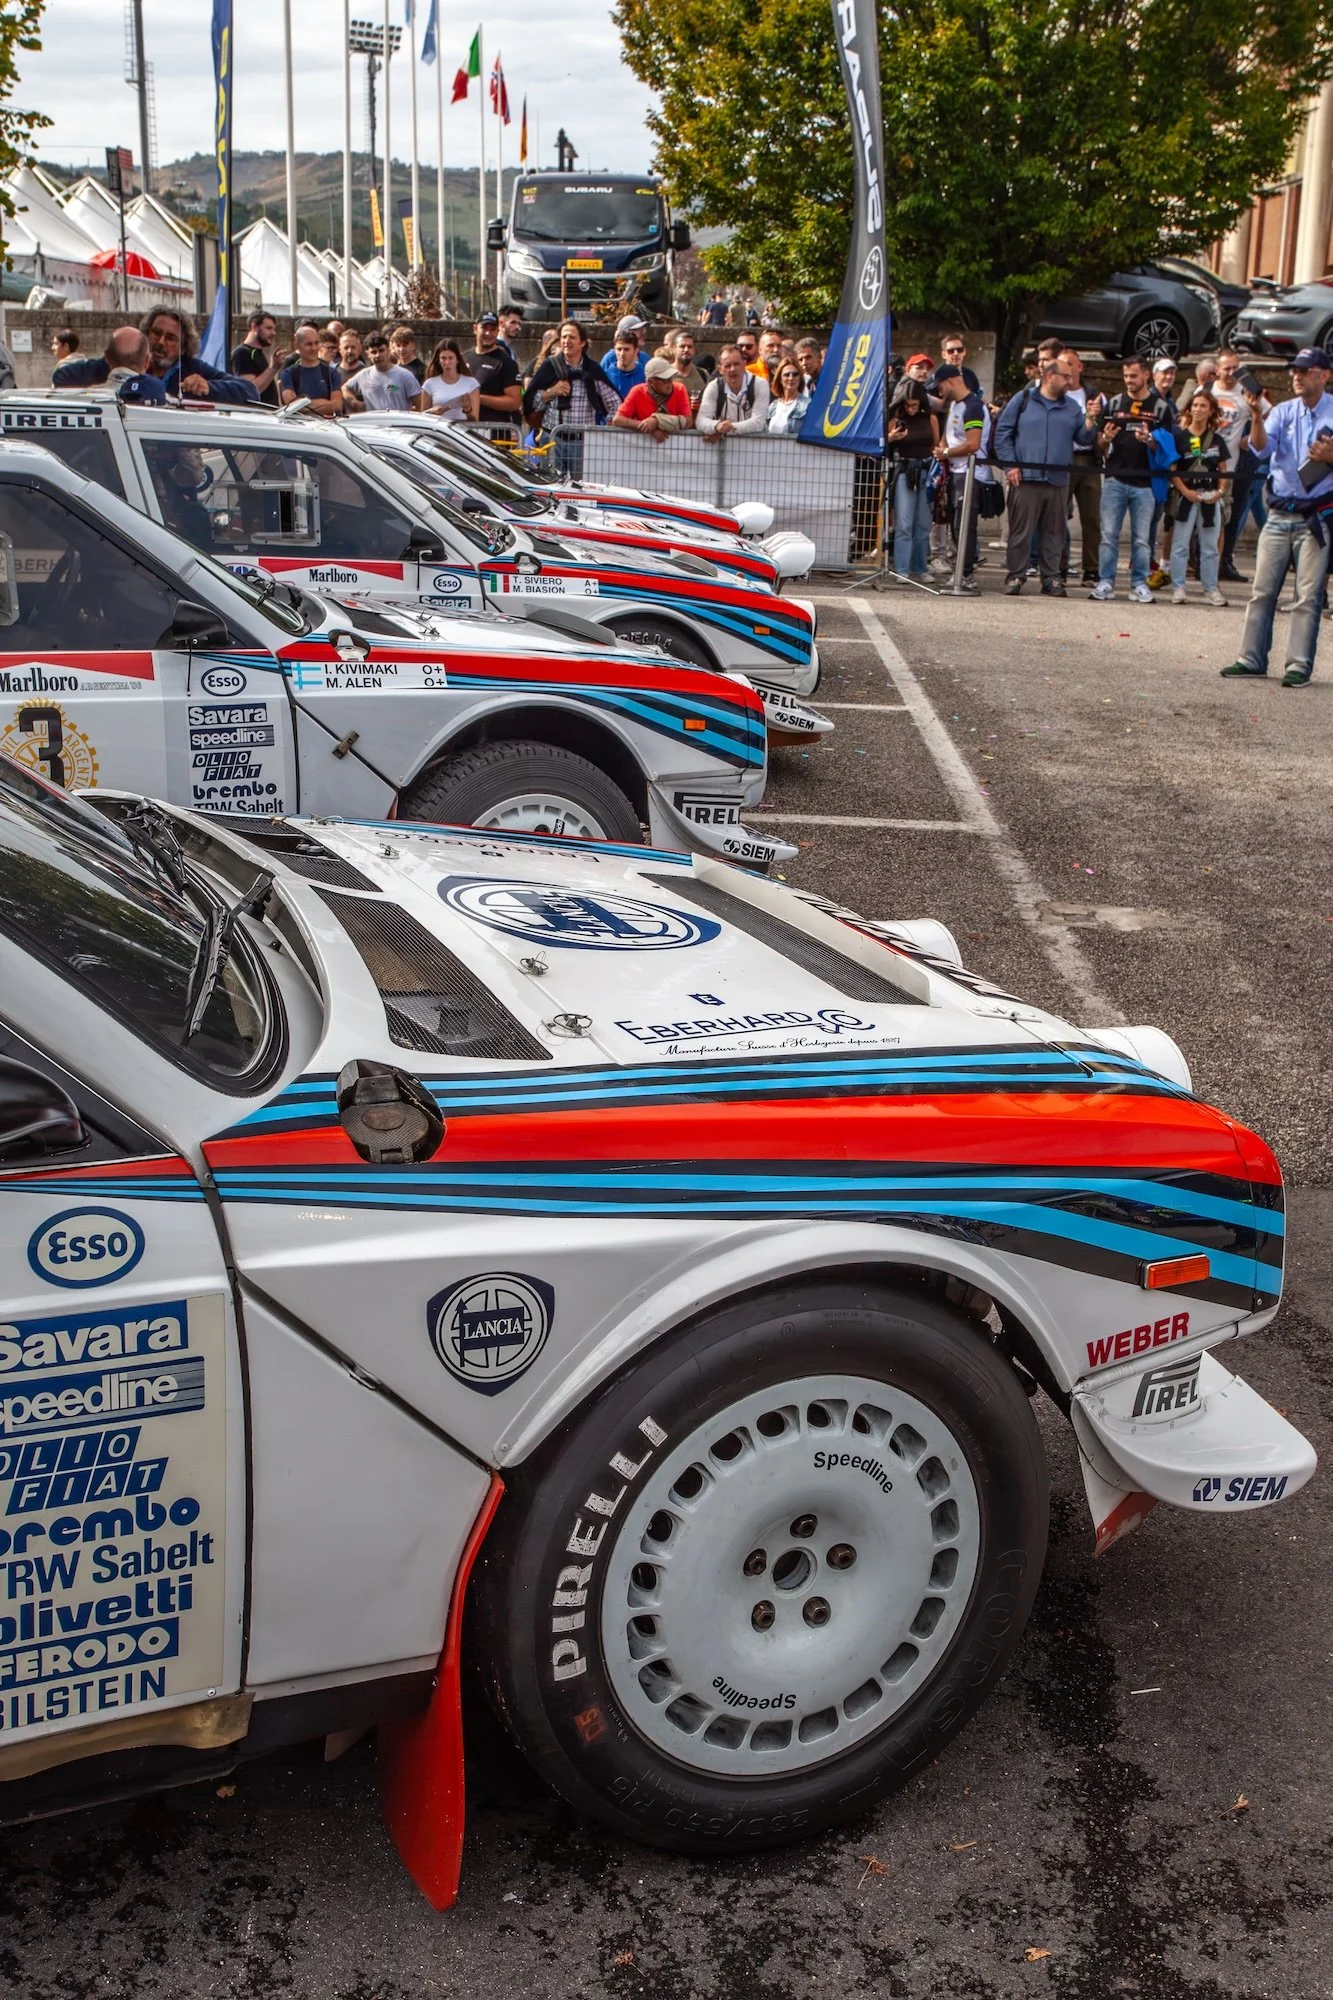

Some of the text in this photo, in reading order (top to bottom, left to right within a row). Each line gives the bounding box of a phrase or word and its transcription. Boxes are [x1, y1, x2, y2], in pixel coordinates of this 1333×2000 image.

[564, 186, 613, 194] SUBARU
[3, 411, 102, 428] IRELLI
[309, 568, 358, 583] Marlboro
[437, 578, 458, 588] Esso
[513, 575, 523, 585] T.
[524, 576, 562, 586] SIVIERO
[512, 585, 524, 593] M.
[525, 585, 566, 594] BIASION
[0, 667, 79, 692] Marlboro
[324, 664, 443, 675] I. KIVIMAKI O+
[207, 675, 240, 688] Esso
[326, 677, 342, 688] M.
[345, 677, 382, 688] ALEN
[189, 706, 267, 726] Savara
[788, 715, 815, 731] SIEM
[19, 707, 65, 788] 3
[191, 728, 266, 749] speedline
[195, 752, 249, 766] OLIO
[206, 766, 261, 780] FIAT
[193, 780, 277, 800] brembo
[741, 843, 776, 862] SIEM
[538, 892, 610, 932] LANCIA
[613, 1011, 813, 1042] EBERHARD
[659, 1044, 738, 1056] Manufacture
[48, 1231, 129, 1265] Esso
[463, 1317, 524, 1340] LANCIA
[0, 1316, 182, 1372] Savara
[1086, 1312, 1190, 1368] WEBER
[0, 1372, 179, 1433] peedline
[813, 1450, 895, 1495] Speedline
[18, 1463, 160, 1509] FIAT
[1224, 1475, 1289, 1502] SIEM
[92, 1529, 215, 1584] Sabelt
[551, 1415, 669, 1682] PIRELLI
[0, 1626, 171, 1686] FERODO
[0, 1665, 166, 1731] ILSTEIN
[712, 1675, 798, 1710] Speedline
